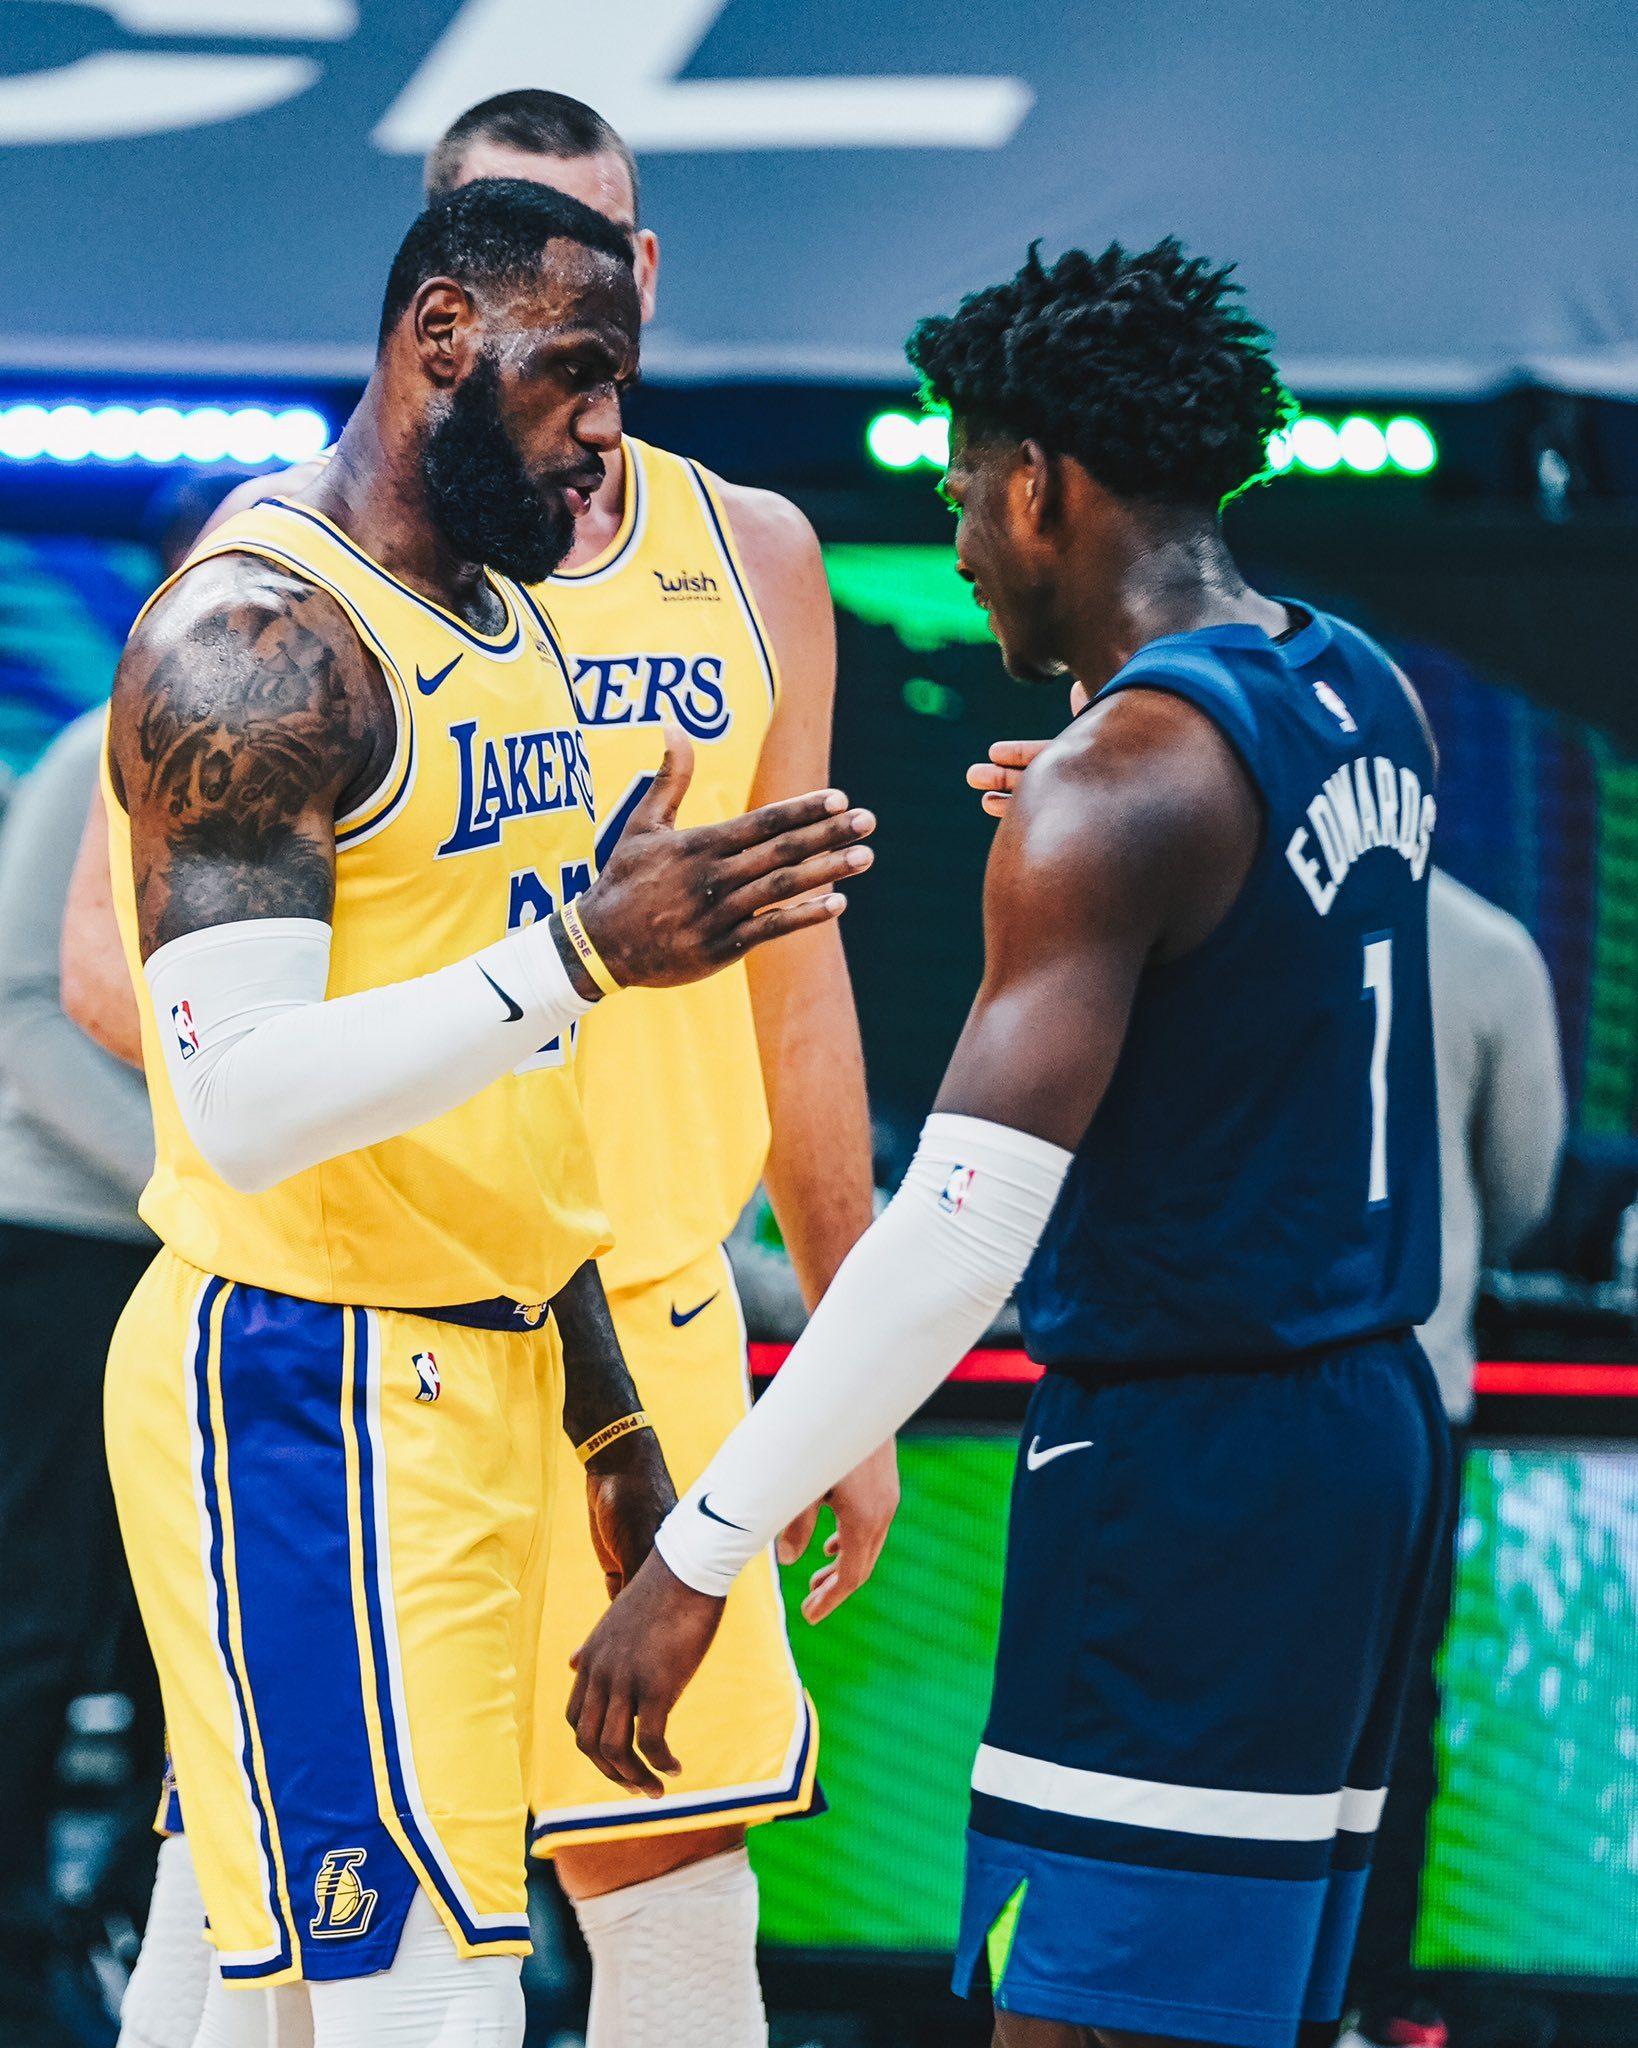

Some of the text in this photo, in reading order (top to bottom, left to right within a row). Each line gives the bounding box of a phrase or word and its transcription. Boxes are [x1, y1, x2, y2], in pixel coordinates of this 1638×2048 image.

[653, 570, 717, 591] wish
[1285, 755, 1437, 916] EDWARDS
[562, 903, 592, 958] ROMISE
[1361, 936, 1394, 1204] 1
[586, 1416, 639, 1452] PROMISE
